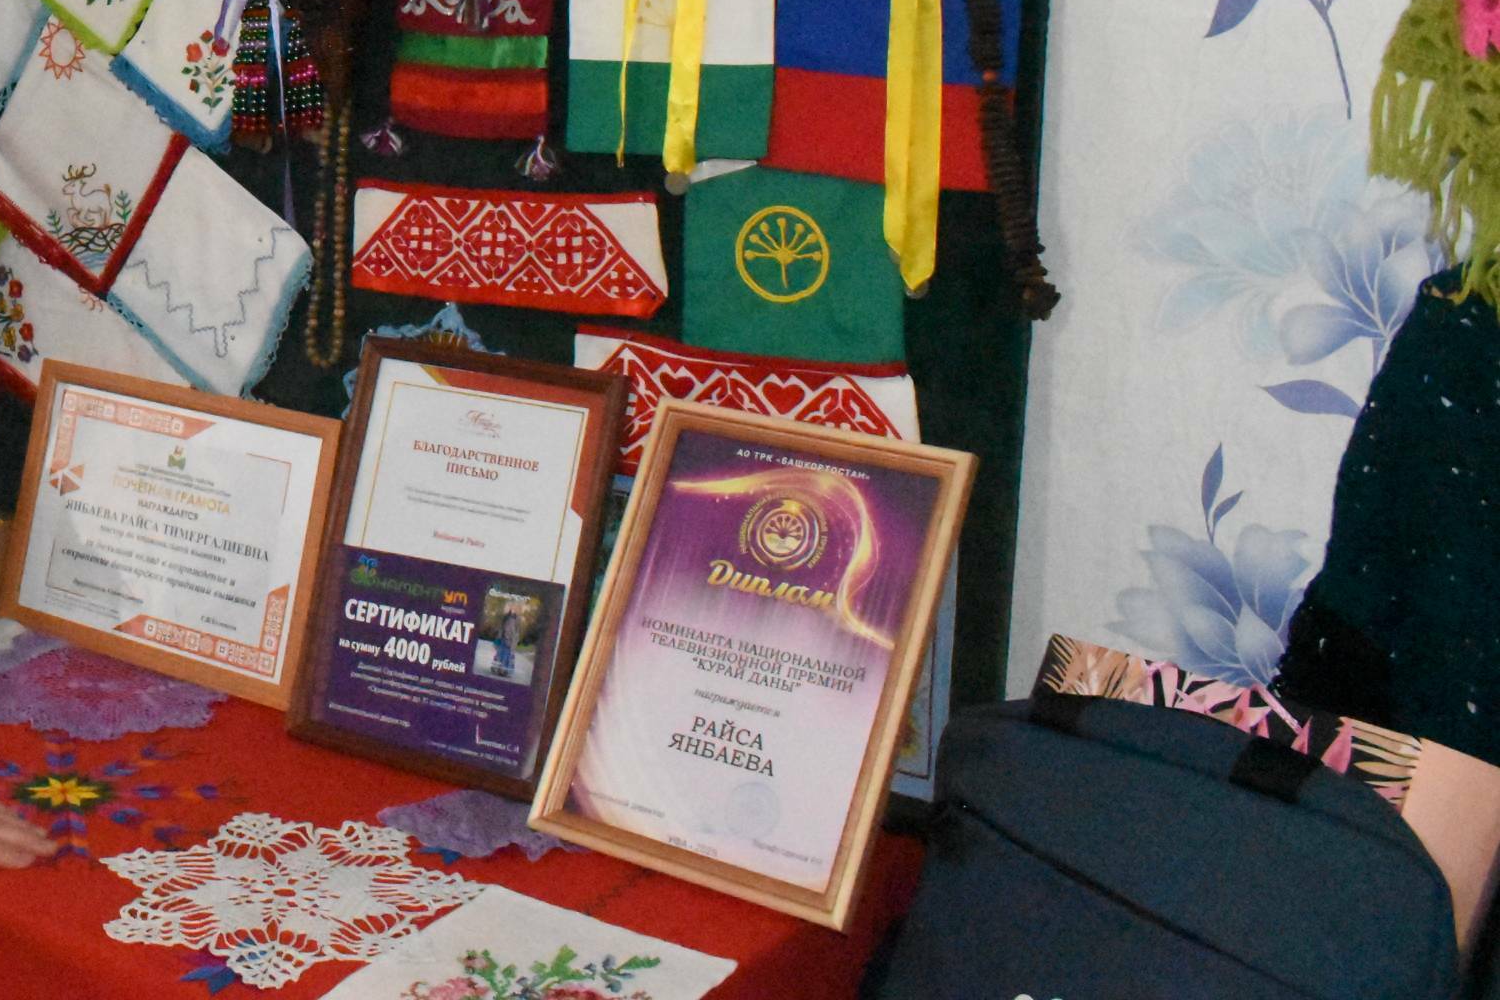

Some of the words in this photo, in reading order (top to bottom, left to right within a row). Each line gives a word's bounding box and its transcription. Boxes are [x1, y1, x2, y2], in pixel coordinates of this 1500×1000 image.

[413, 439, 540, 472] БЛАГОДАРСТВЕННОЕ
[446, 461, 499, 481] ПИСЬМО
[736, 448, 750, 459] АО
[754, 451, 773, 463] ТРК
[65, 499, 118, 521] ЯНБАЕВА
[120, 511, 160, 533] РАЙСА
[345, 598, 475, 644] СЕРТИФИКАТ
[339, 637, 350, 648] на
[351, 640, 381, 657] сумму
[384, 636, 431, 665] 4000
[431, 658, 466, 674] рублей
[642, 616, 733, 649] НОМИНАНТА
[737, 640, 867, 682] НАЦИОНАЛЬНОЙ
[650, 632, 782, 676] ТЕЛЕВИЗИОННОЙ
[787, 667, 854, 694] ПРЕМИИ
[691, 715, 764, 751] РАЙСА
[668, 732, 775, 777] ЯНБАЕВА
